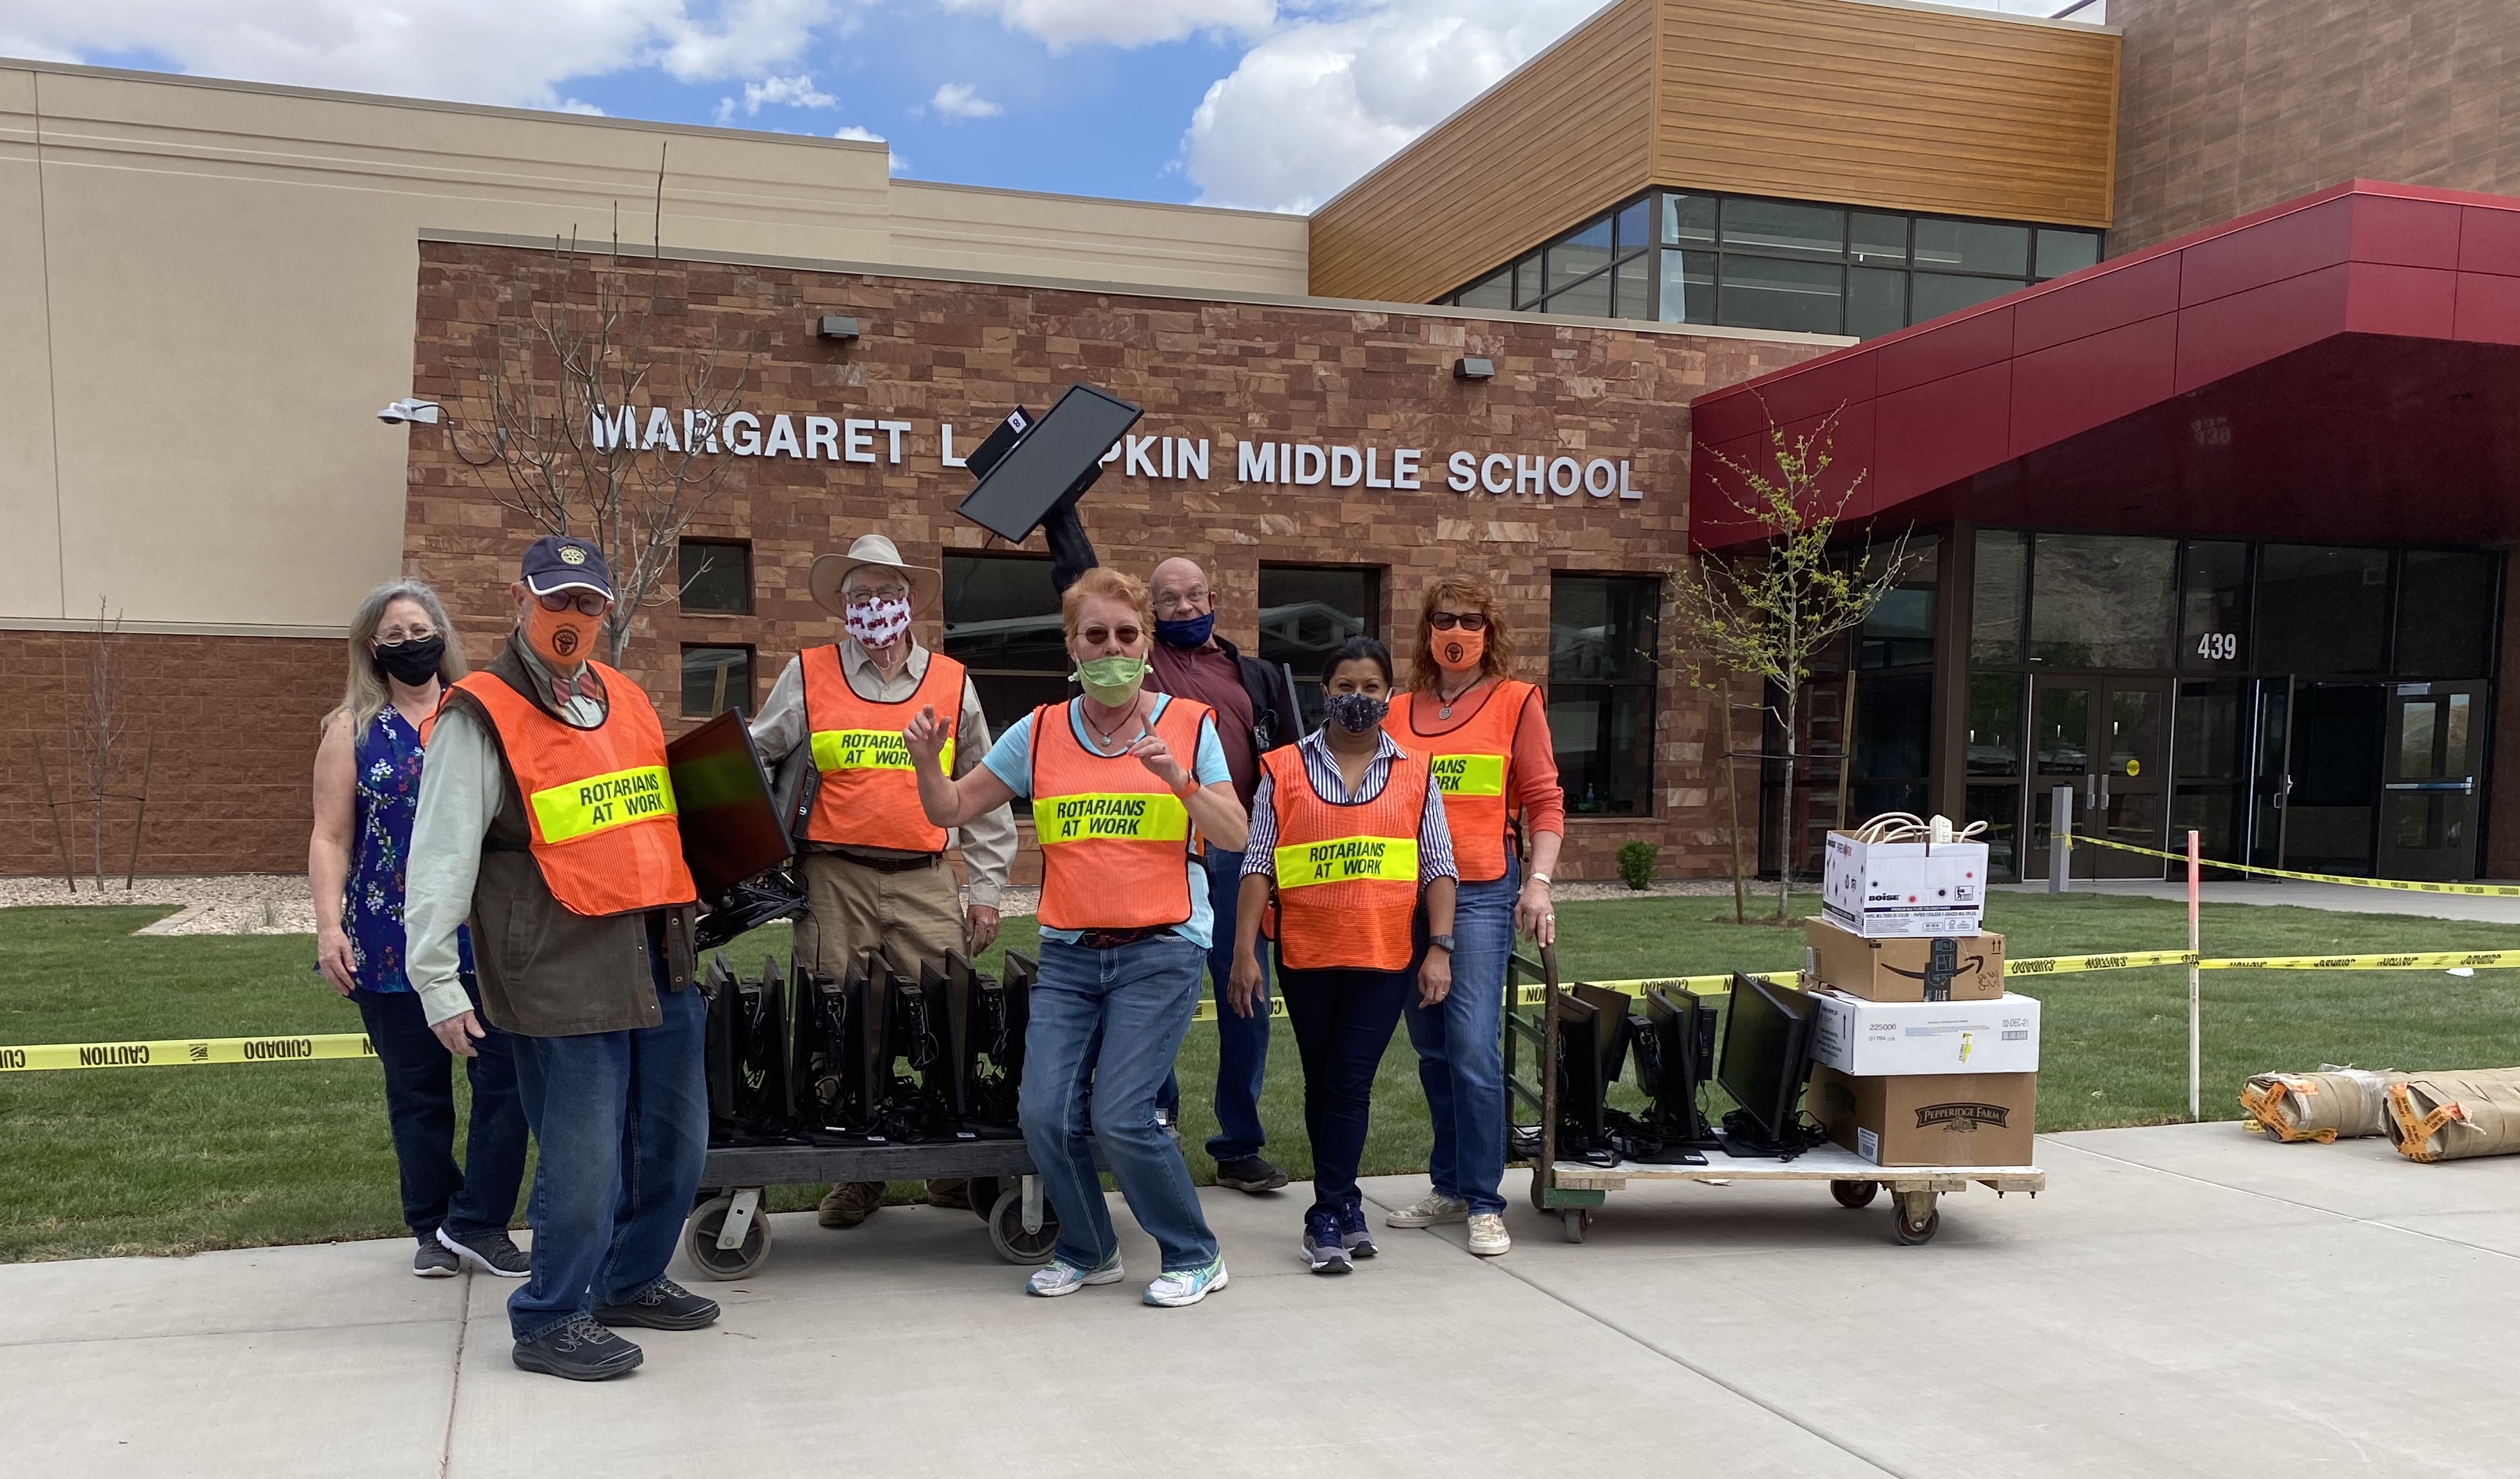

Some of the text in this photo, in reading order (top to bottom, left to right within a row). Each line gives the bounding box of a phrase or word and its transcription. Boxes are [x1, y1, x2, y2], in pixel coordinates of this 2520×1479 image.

[591, 403, 911, 464] MARGARET
[1237, 441, 1422, 490] MIDDLE
[1447, 451, 1643, 499] SCHOOL
[2197, 632, 2237, 660] 439
[841, 734, 907, 749] ROTARIA
[844, 750, 865, 765] AT
[580, 774, 659, 806] ROTARIANS
[593, 793, 666, 825] AT WORK
[1057, 799, 1146, 819] ROTARIANS
[1061, 817, 1141, 838] AT WORK
[1310, 841, 1386, 863] ROTARIANS
[1314, 858, 1383, 879] AT WORK
[80, 1038, 312, 1066] CUIDADO CAUTION
[1924, 1108, 2000, 1122] PEPPERIDGE FARM
[2395, 1097, 2406, 1117] FORKLIFT
[2424, 1110, 2441, 1126] FORKLIFT
[2430, 1121, 2439, 1130] NOT
[2405, 1124, 2415, 1145] FORKLIFT
